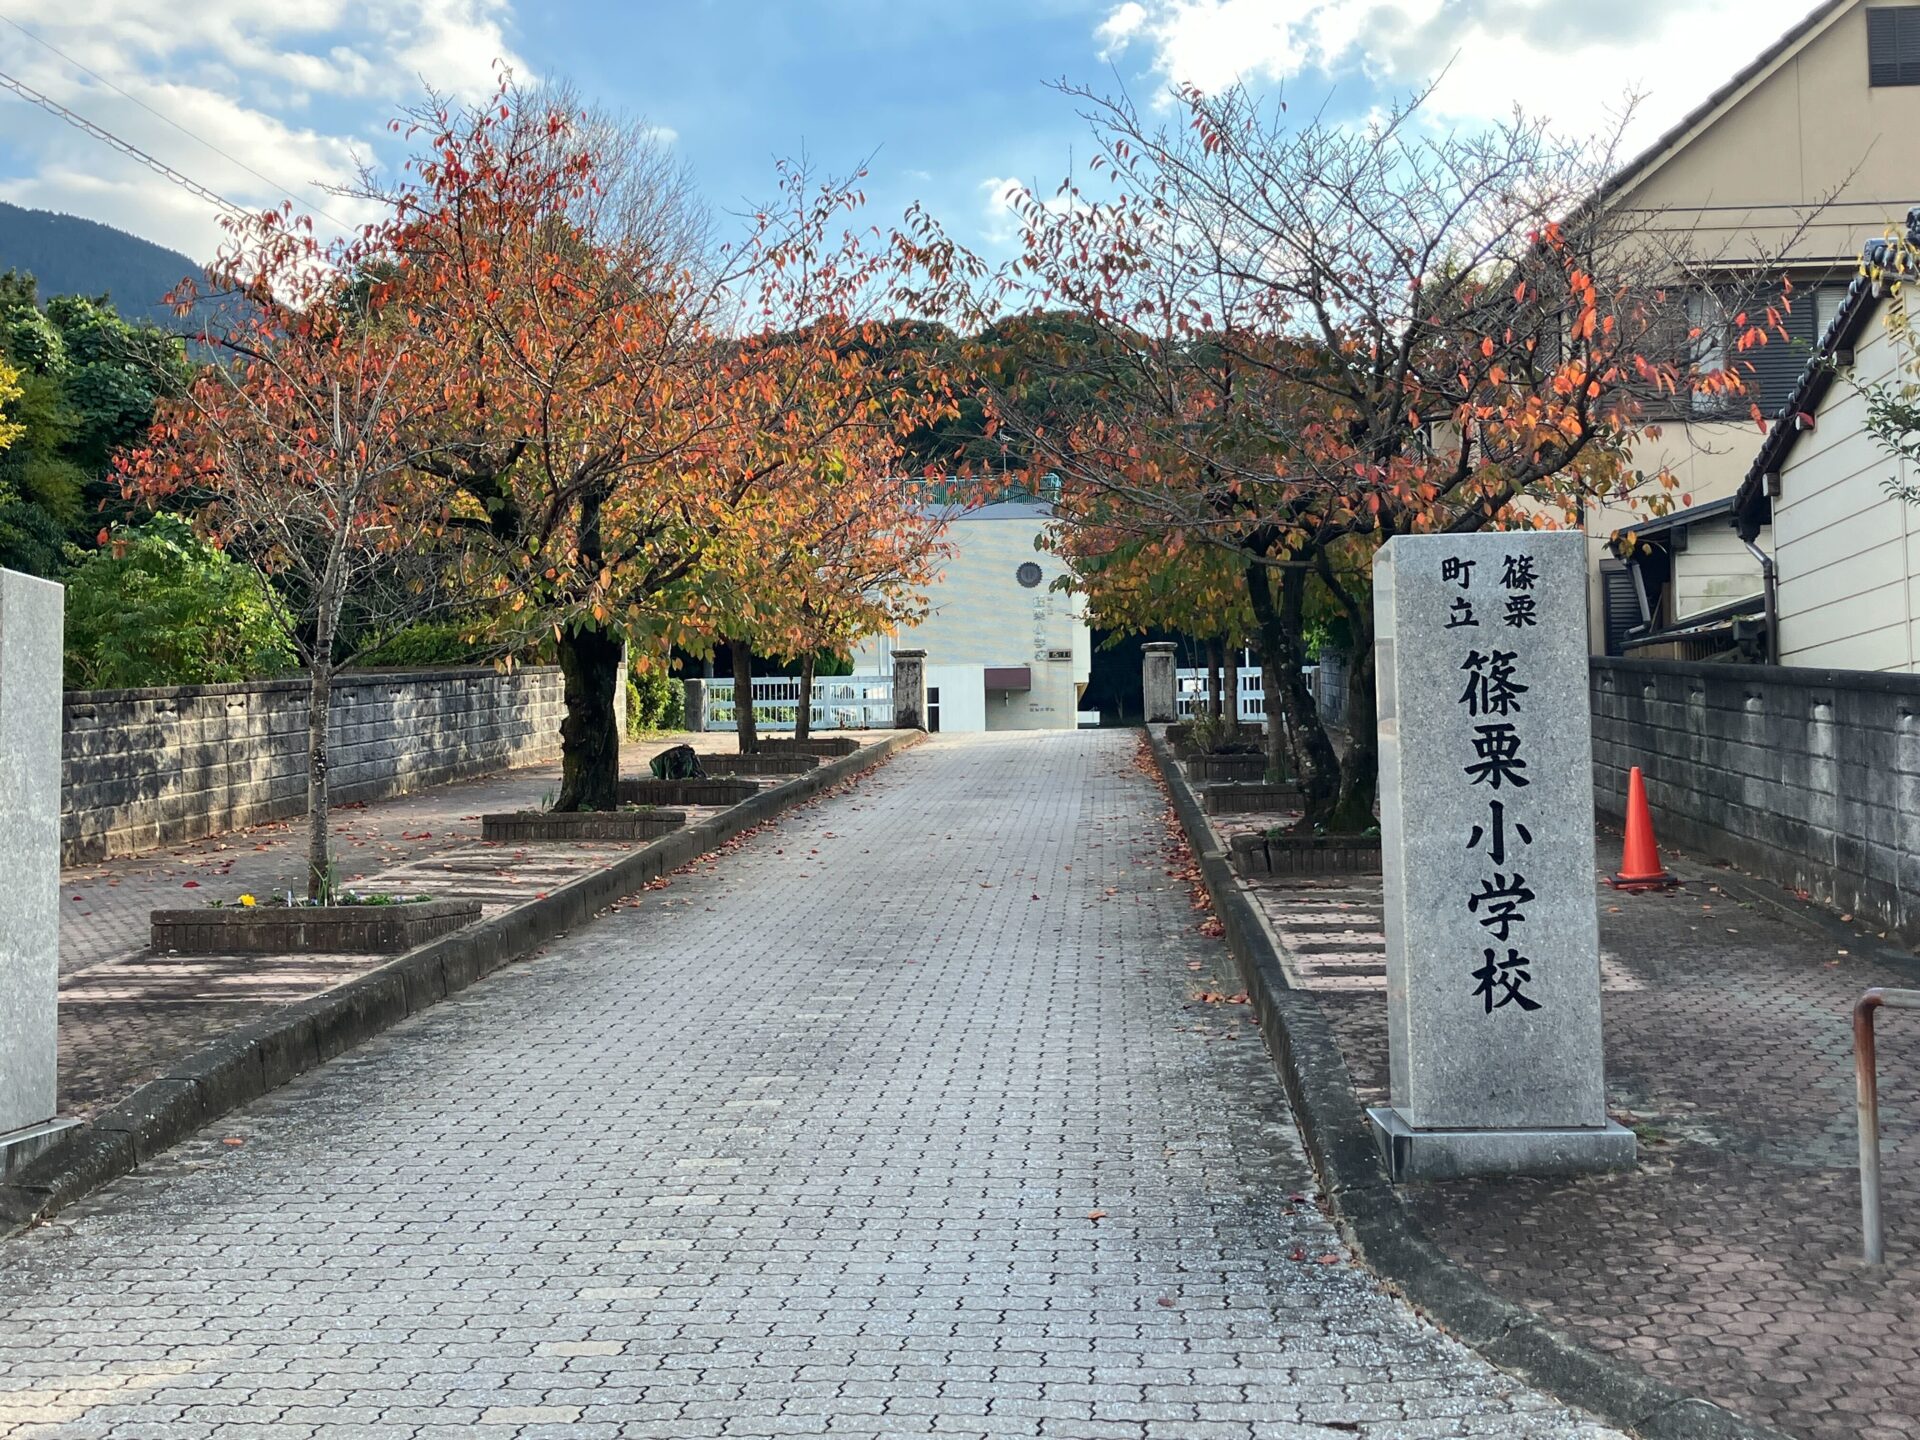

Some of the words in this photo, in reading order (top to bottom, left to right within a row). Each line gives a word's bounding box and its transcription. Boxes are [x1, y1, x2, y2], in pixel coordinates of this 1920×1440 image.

[1442, 556, 1479, 629] 町立
[1499, 554, 1539, 629] 篠栗
[1459, 650, 1542, 1014] 篠栗小学校
